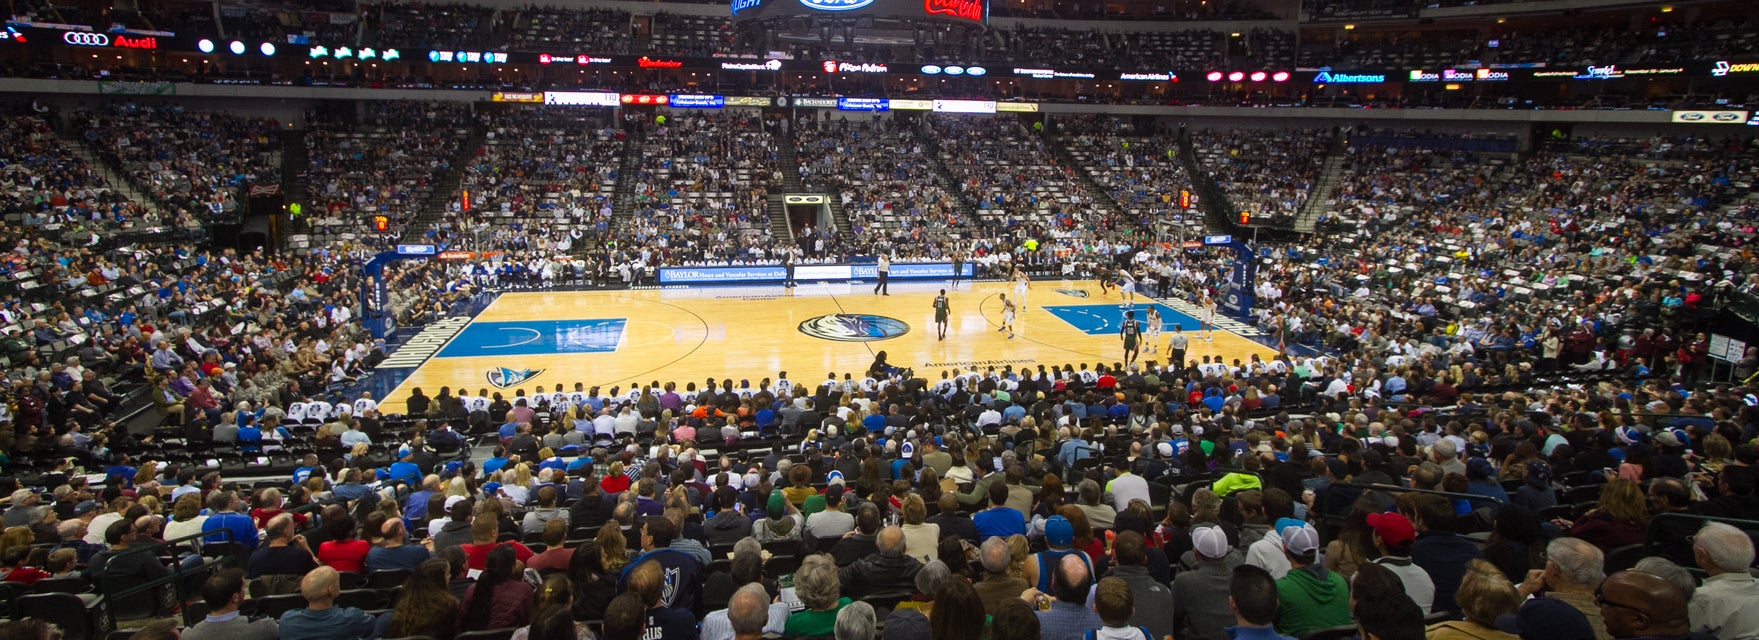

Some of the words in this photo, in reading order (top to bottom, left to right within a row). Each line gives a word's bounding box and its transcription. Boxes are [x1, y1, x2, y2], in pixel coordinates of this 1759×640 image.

[113, 35, 157, 49] Audi
[1332, 74, 1385, 83] Albertsons
[670, 270, 700, 279] BAYLOR
[925, 359, 1036, 367] AmericanAirlines
